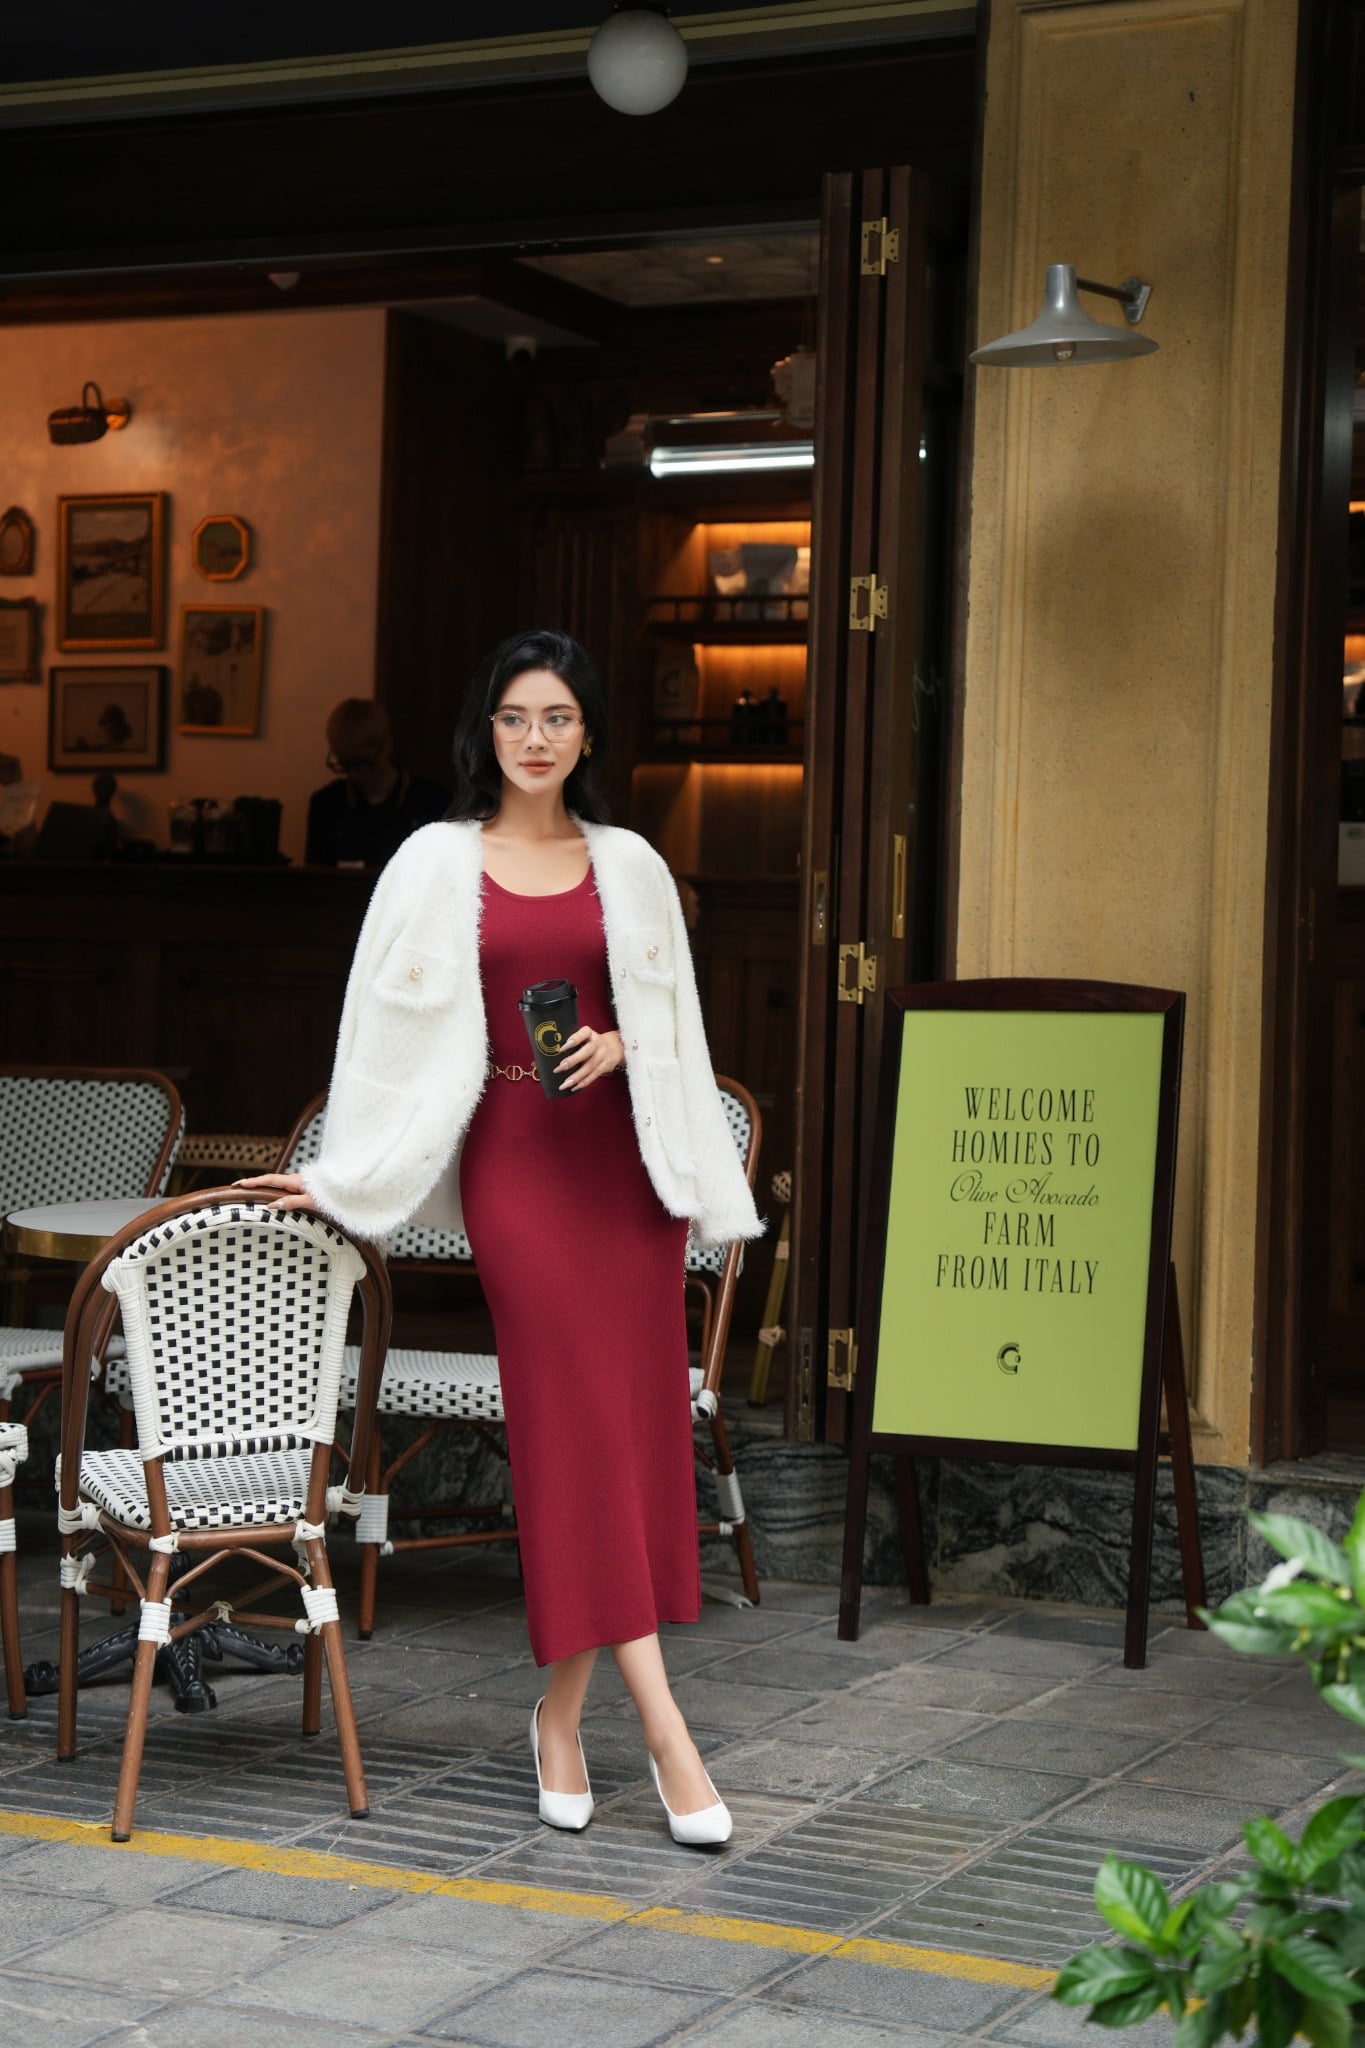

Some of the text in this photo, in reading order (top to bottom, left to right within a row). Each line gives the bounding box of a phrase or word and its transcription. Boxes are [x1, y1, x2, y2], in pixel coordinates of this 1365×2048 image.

[965, 1087, 1094, 1122] WELCOME
[952, 1130, 1099, 1167] HOMIES TO
[950, 1170, 1099, 1206] Olive Avocado
[984, 1212, 1054, 1247] FARM
[936, 1254, 1099, 1294] FROM ITALY
